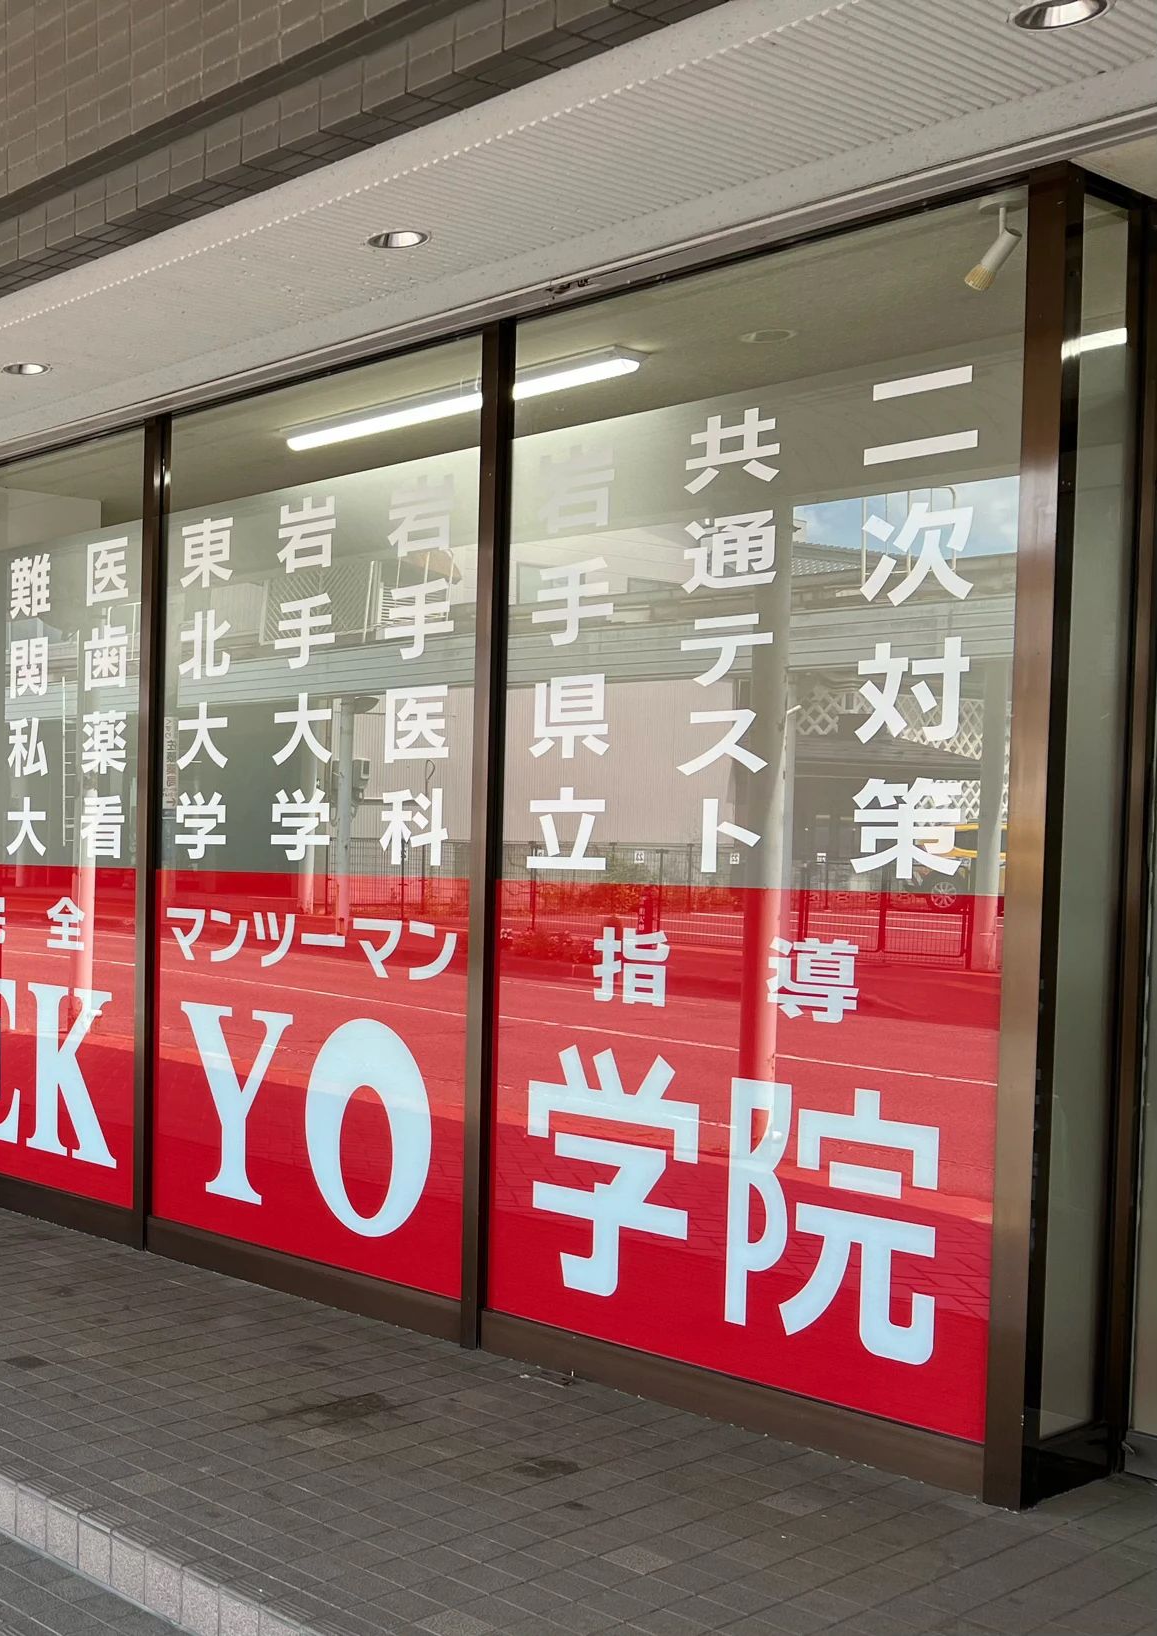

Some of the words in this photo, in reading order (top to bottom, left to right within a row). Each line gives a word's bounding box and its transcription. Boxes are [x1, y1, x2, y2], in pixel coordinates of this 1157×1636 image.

[5, 552, 52, 857] 難関私大
[79, 536, 129, 859] 医歯薬看
[174, 517, 234, 860] 東北大学
[270, 495, 337, 861] 岩手大学
[379, 474, 455, 867] 岩手医科
[526, 443, 615, 871] 岩手県立
[675, 408, 781, 874] 共通テスト
[849, 365, 979, 880] 二次対策
[166, 907, 458, 981] マンツーマン
[593, 926, 860, 1024] 指導
[527, 1044, 940, 1366] 学院
